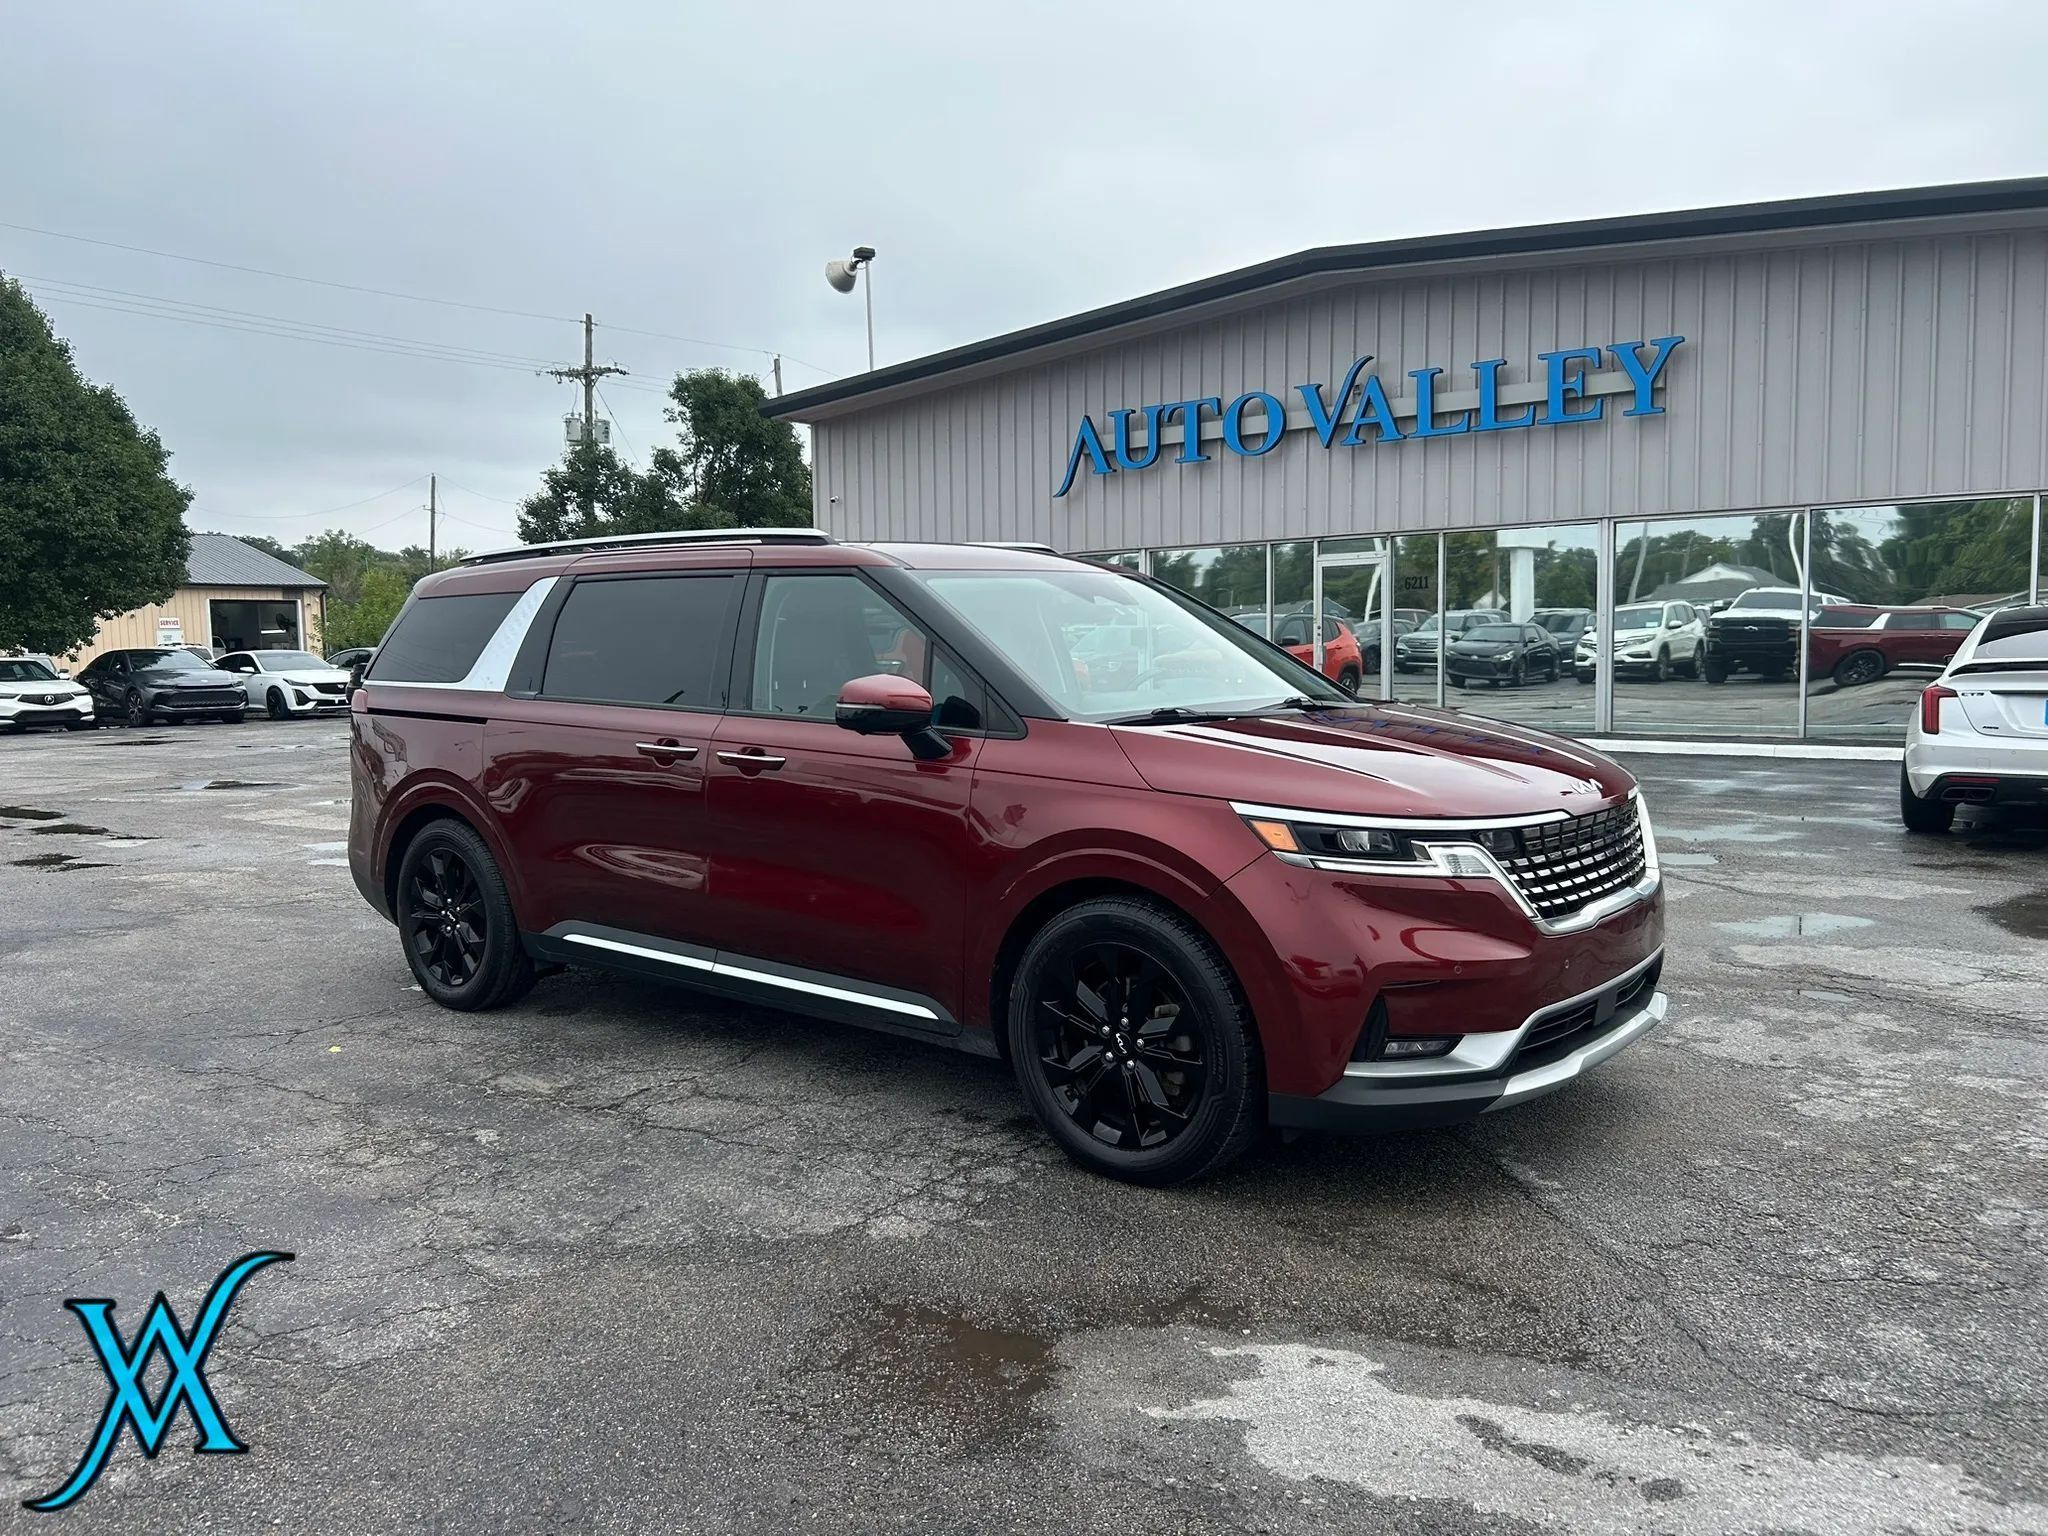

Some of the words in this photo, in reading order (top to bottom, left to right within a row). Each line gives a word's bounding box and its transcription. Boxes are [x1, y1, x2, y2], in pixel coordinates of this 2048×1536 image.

[1053, 391, 1287, 498] AUTO
[1295, 336, 1685, 449] VALLEY
[1404, 576, 1430, 590] 6211
